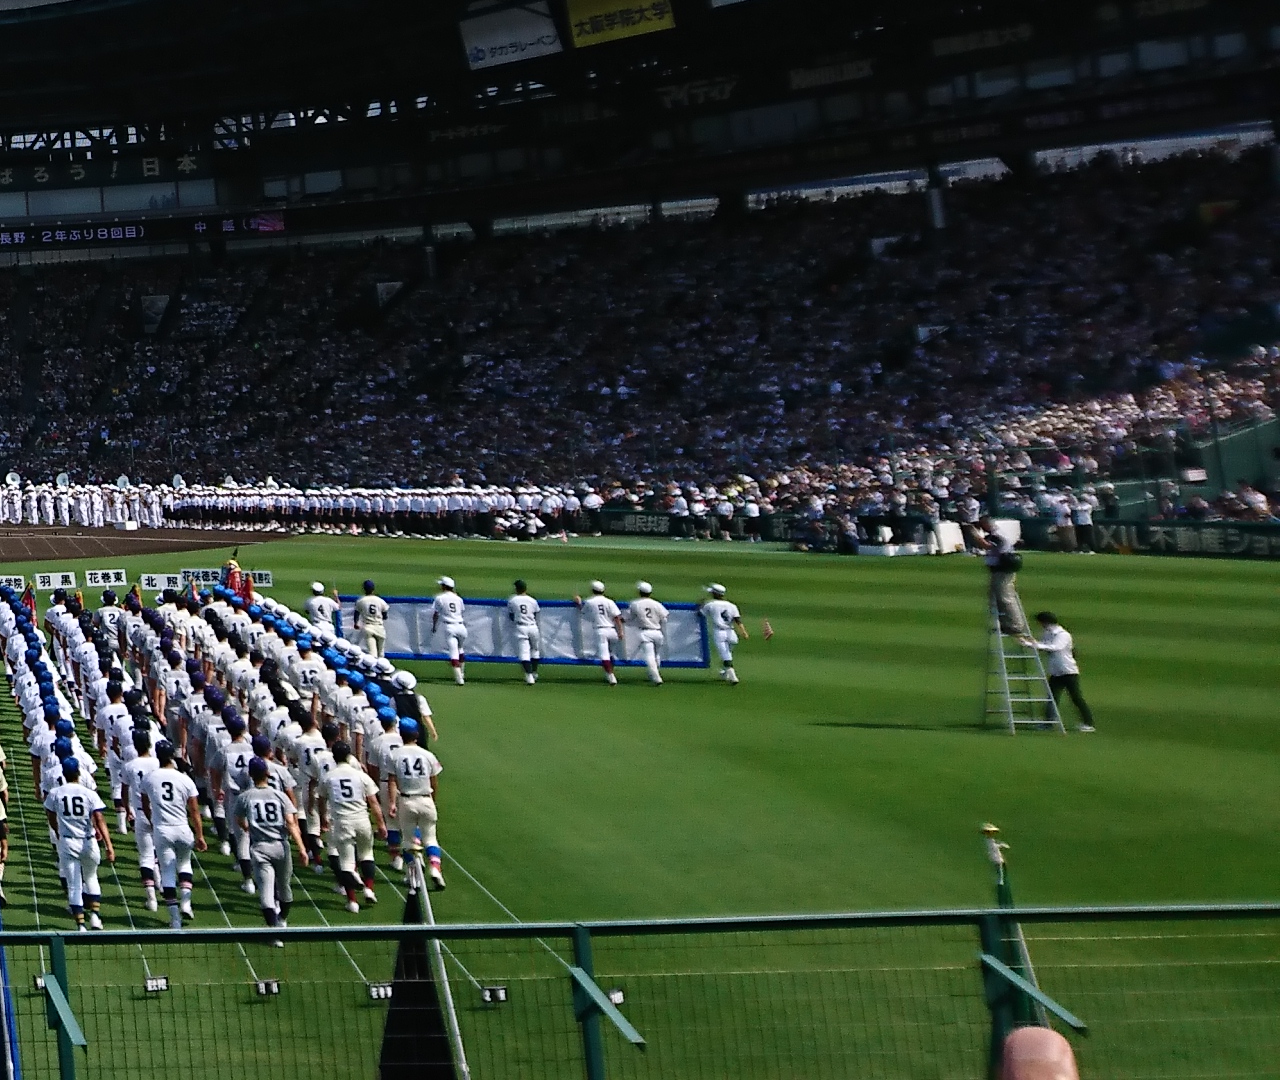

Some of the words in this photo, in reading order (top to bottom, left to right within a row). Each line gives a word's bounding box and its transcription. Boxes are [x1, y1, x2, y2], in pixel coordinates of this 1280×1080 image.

[574, 0, 671, 38] 大阪学院大学
[40, 575, 73, 587] 羽黒
[88, 571, 123, 584] 花巻東
[145, 576, 179, 588] 北照
[318, 605, 325, 614] 4
[369, 605, 376, 614] 6
[450, 604, 456, 613] 9
[521, 605, 527, 613] 8
[646, 608, 652, 618] 2
[109, 613, 116, 624] 2
[235, 755, 245, 768] 4
[403, 758, 425, 775] 14
[162, 782, 173, 800] 3
[340, 779, 353, 798] 5
[62, 797, 84, 816] 16
[255, 803, 277, 821] 18
